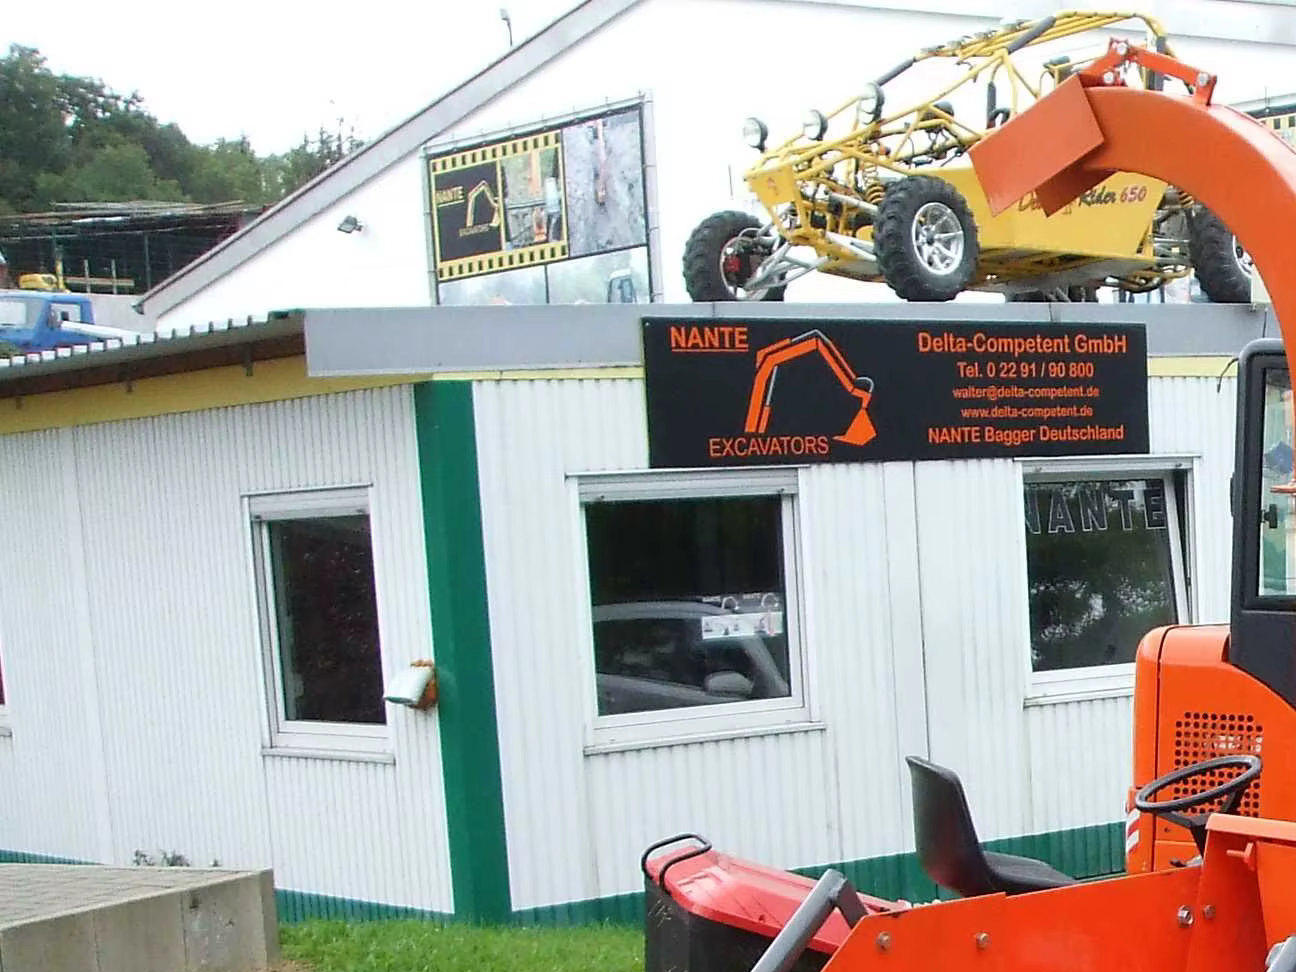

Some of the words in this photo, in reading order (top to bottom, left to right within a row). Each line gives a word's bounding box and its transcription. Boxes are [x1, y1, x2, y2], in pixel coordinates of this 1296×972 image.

[1120, 185, 1147, 203] 650
[670, 326, 748, 348] NANTE
[918, 331, 1071, 358] Delta-Competent
[1074, 334, 1127, 353] GmbH
[956, 361, 982, 378] Tel.
[986, 361, 996, 378] 0
[1000, 361, 1017, 378] 22
[1020, 361, 1036, 378] 91
[1048, 361, 1065, 378] 90
[1069, 361, 1094, 378] 800
[952, 385, 1100, 400] walter@delta-competent.de
[960, 404, 1093, 420] www.delta-competent.de
[928, 427, 981, 443] NANTE
[985, 426, 1036, 446] Bagger
[1040, 424, 1124, 441] Deutschland
[708, 436, 830, 458] EXCAVATORS
